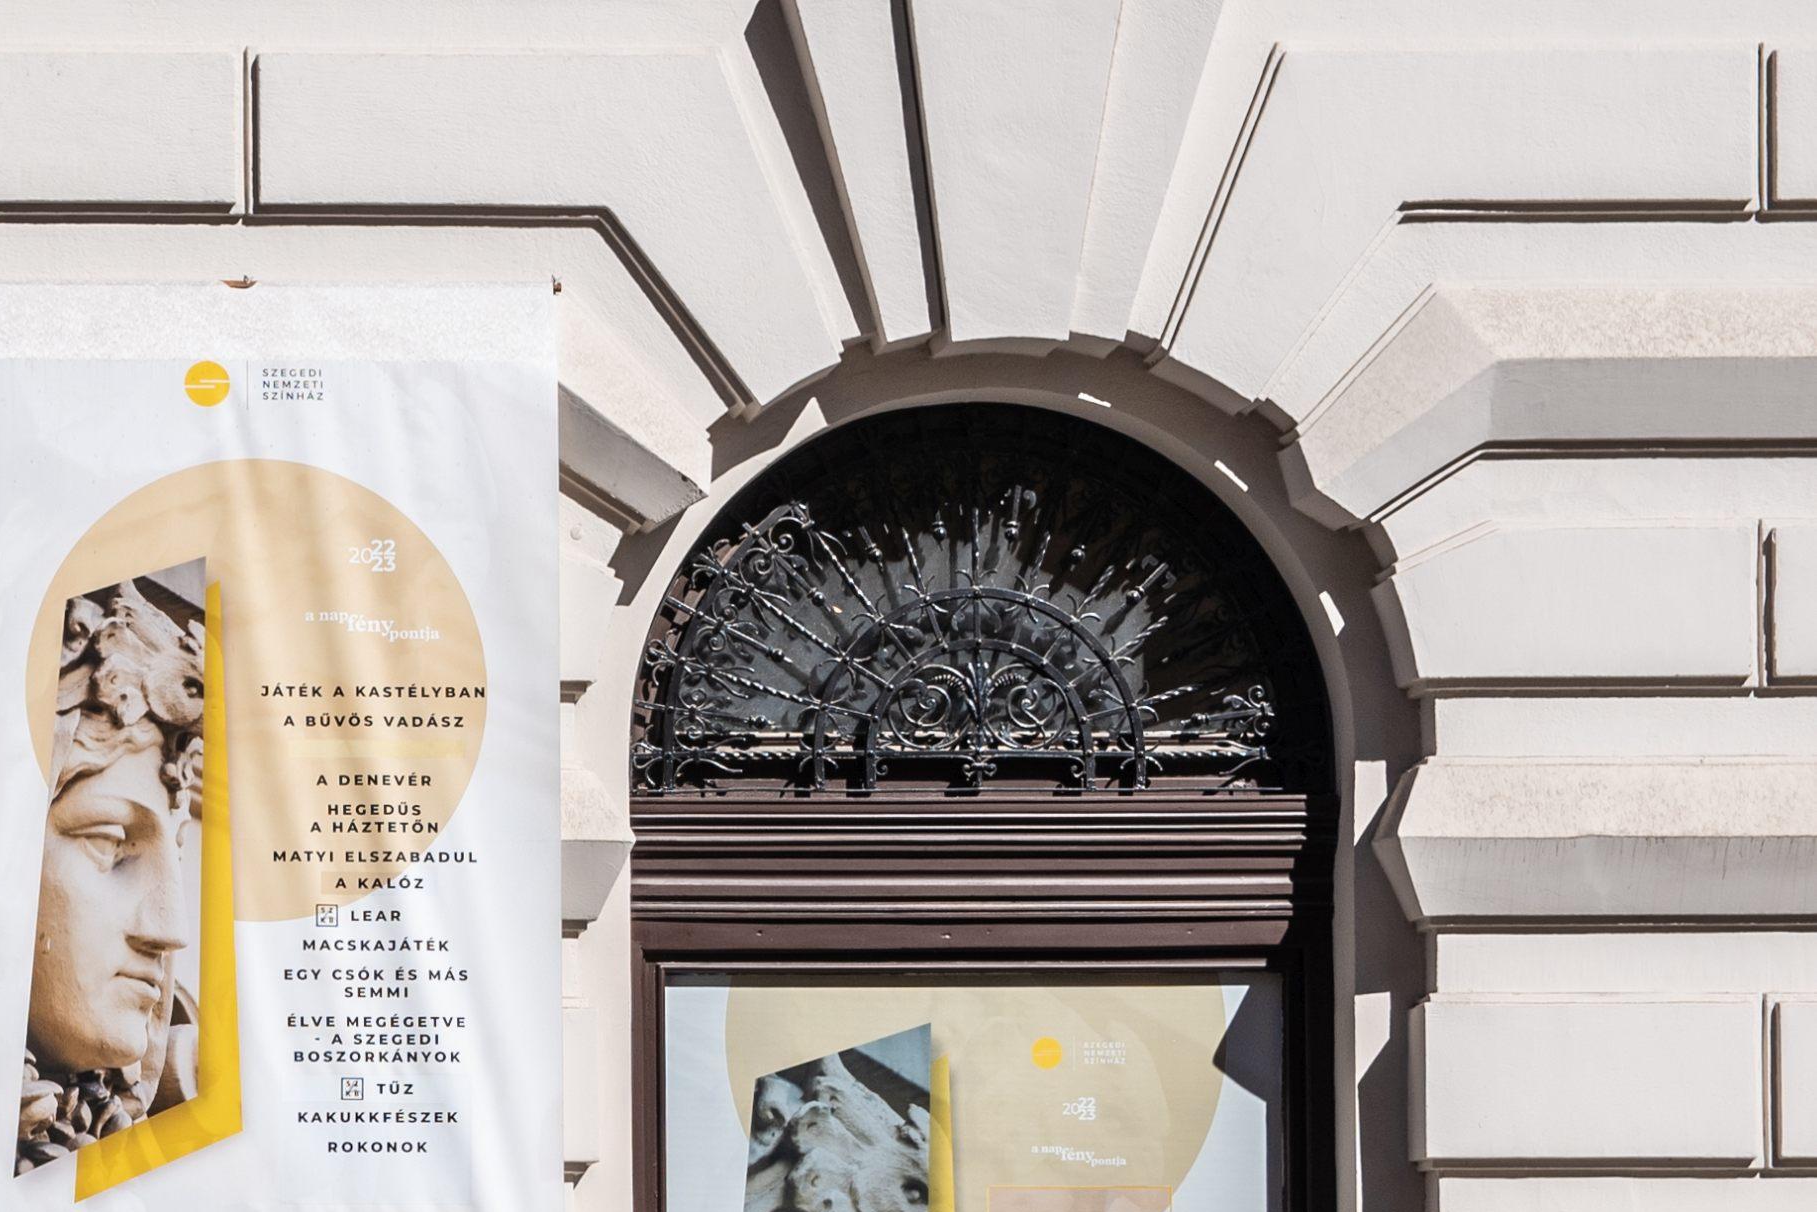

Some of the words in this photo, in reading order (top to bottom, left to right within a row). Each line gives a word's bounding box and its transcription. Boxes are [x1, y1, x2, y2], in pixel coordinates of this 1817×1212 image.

[263, 369, 322, 377] SZEGEDI
[263, 390, 324, 400] SZÍNHÁZ
[305, 611, 314, 621] a
[261, 683, 322, 697] JÁTÉK
[333, 687, 344, 696] A
[356, 684, 485, 698] KASTÉLYBAN
[284, 716, 295, 726] A
[306, 713, 373, 727] BŰVÖS
[384, 714, 464, 727] VADÁSZ
[317, 776, 327, 786] A
[339, 773, 431, 786] DENEVÉR
[328, 802, 421, 816] HEGEDŰS
[311, 823, 321, 832] A
[333, 819, 438, 833] HÁZTETŐN
[274, 851, 333, 862] MATYI
[345, 851, 477, 863] ELSZABADUL
[336, 879, 346, 888] A
[358, 875, 423, 889] KALÓZ
[351, 911, 401, 921] LEAR
[303, 937, 449, 951] MACSKAJÁTÉK
[284, 969, 321, 980] EGY
[332, 966, 384, 980] CSÓK
[396, 967, 417, 980] ÉS
[429, 967, 468, 981] MÁS
[345, 987, 408, 998] SEMMI
[287, 1014, 335, 1027] ÉLVE
[347, 1014, 465, 1028] MEGÉGETVE
[332, 1034, 342, 1044] A
[354, 1034, 439, 1045] SZEGEDI
[294, 1049, 461, 1062] BOSZORKÁNYOK
[377, 1081, 414, 1095] TŰZ
[298, 1110, 458, 1123] KAKUKKFÉSZEK
[328, 1142, 428, 1153] ROKONOK
